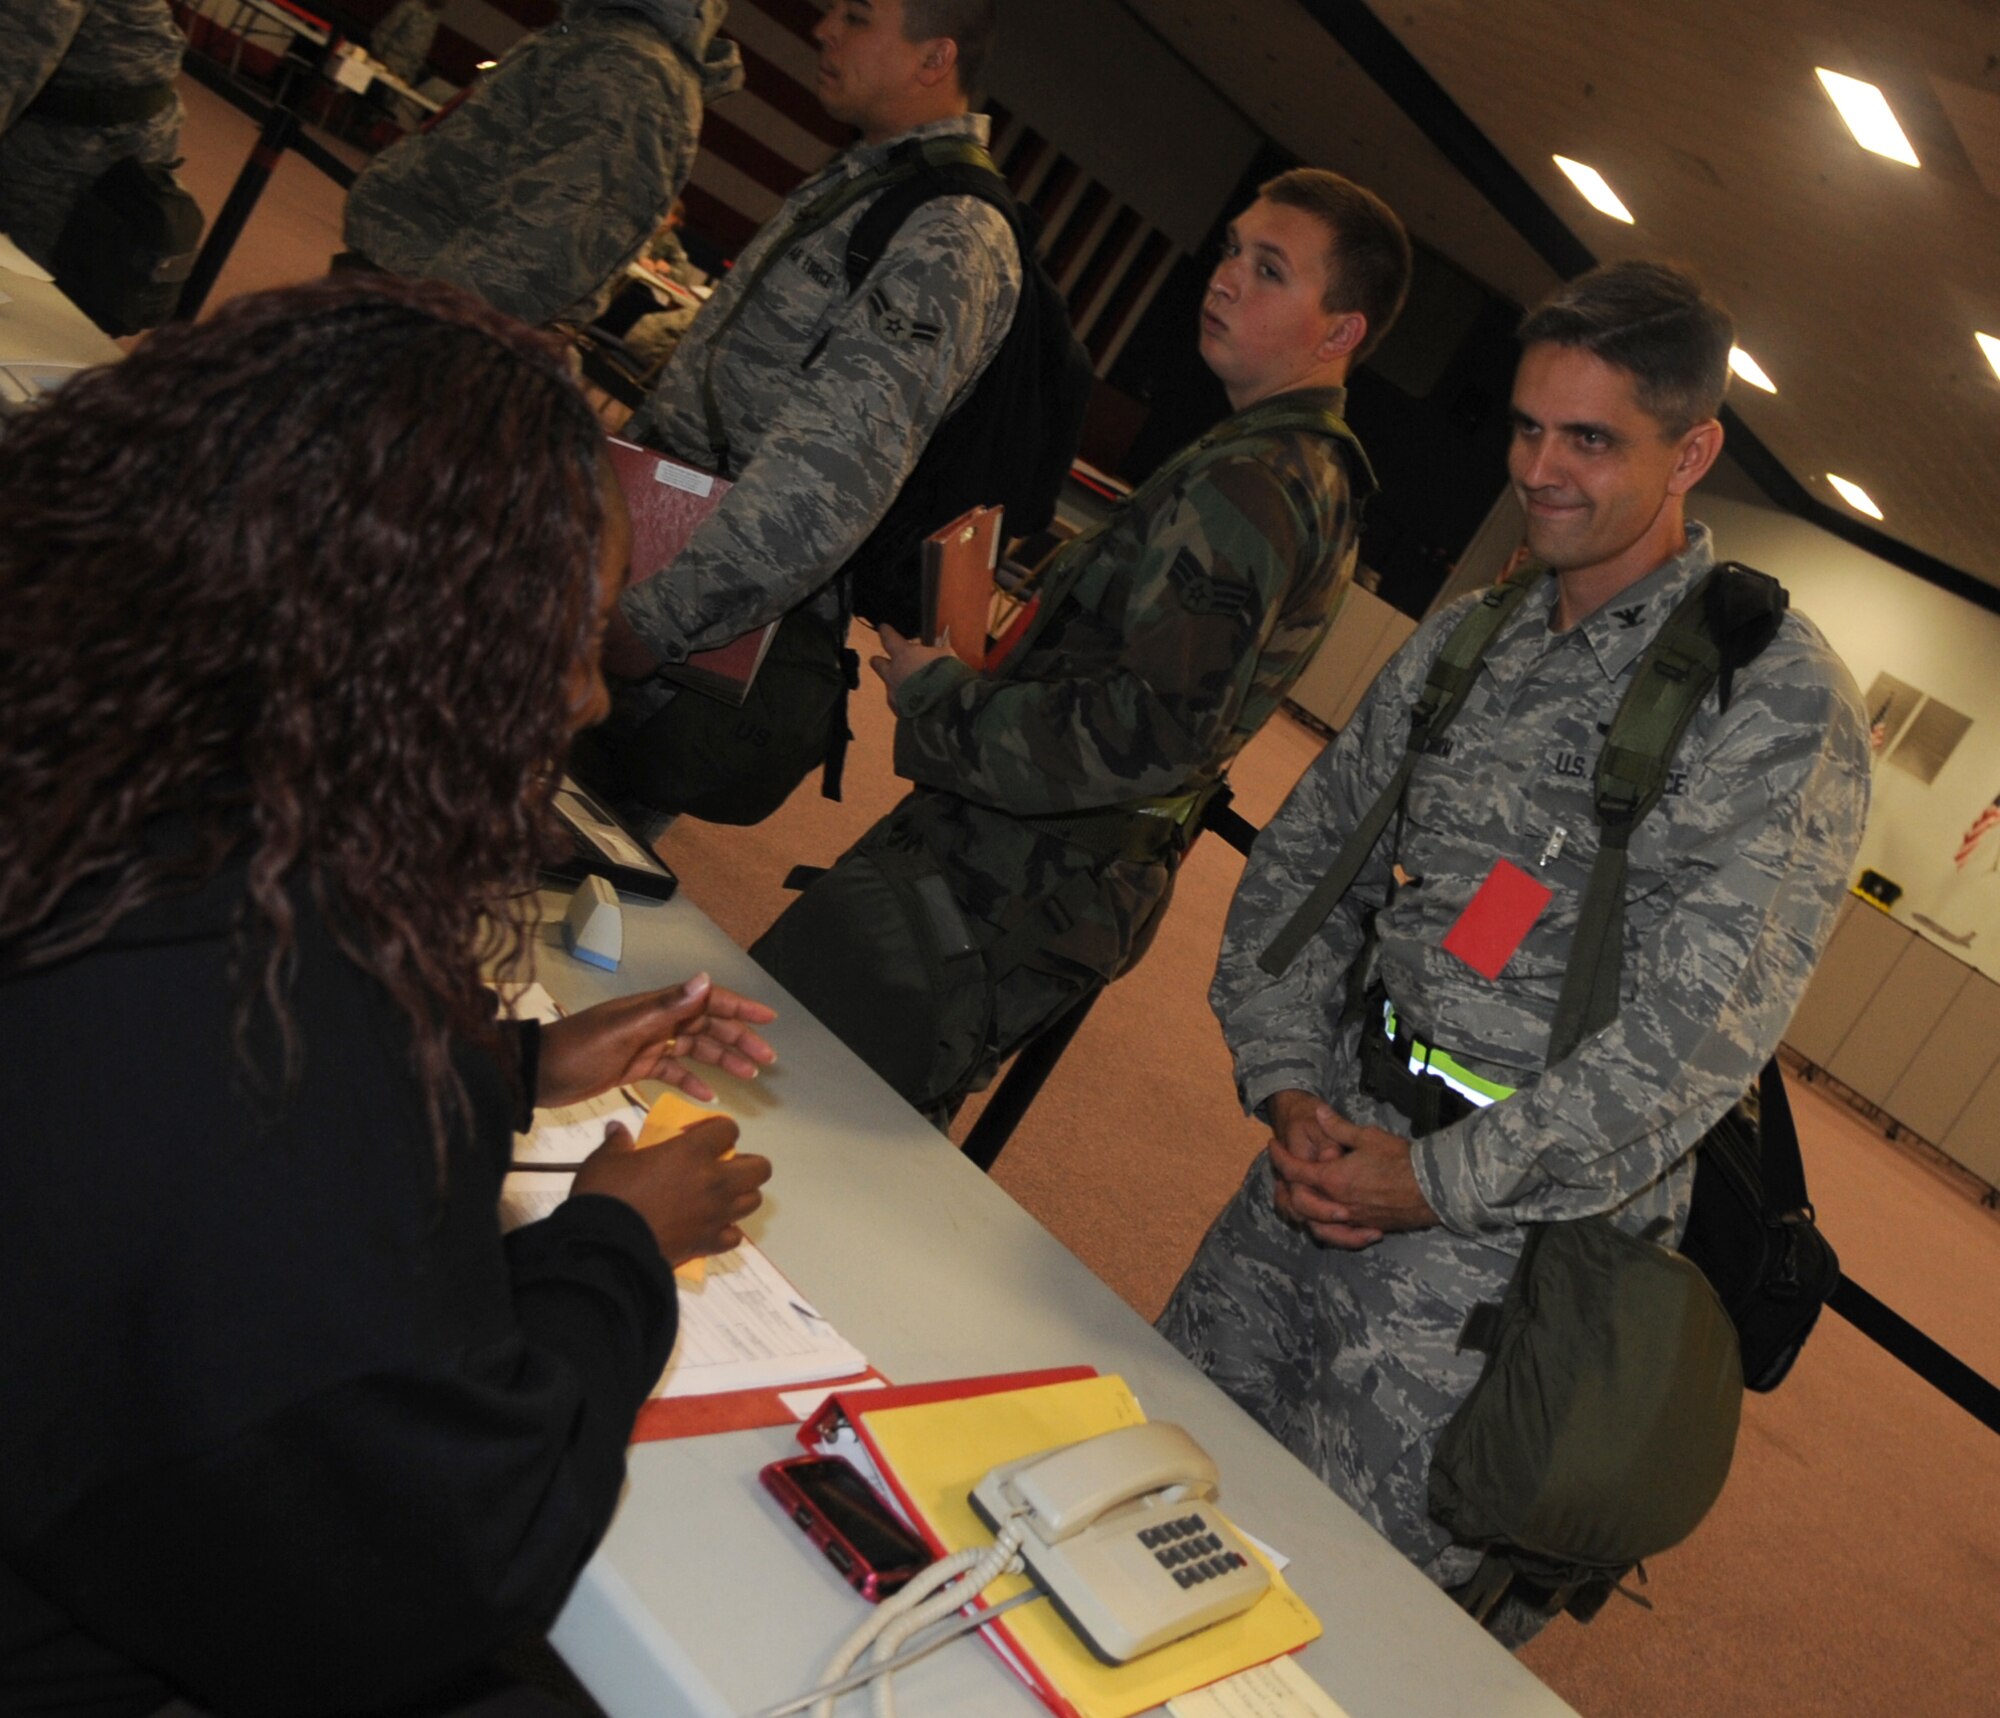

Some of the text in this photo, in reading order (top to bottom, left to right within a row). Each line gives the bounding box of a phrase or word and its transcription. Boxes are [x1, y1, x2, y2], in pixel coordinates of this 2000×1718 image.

[801, 256, 836, 289] FORCE
[735, 719, 772, 747] US
[1555, 751, 1587, 779] U.S.
